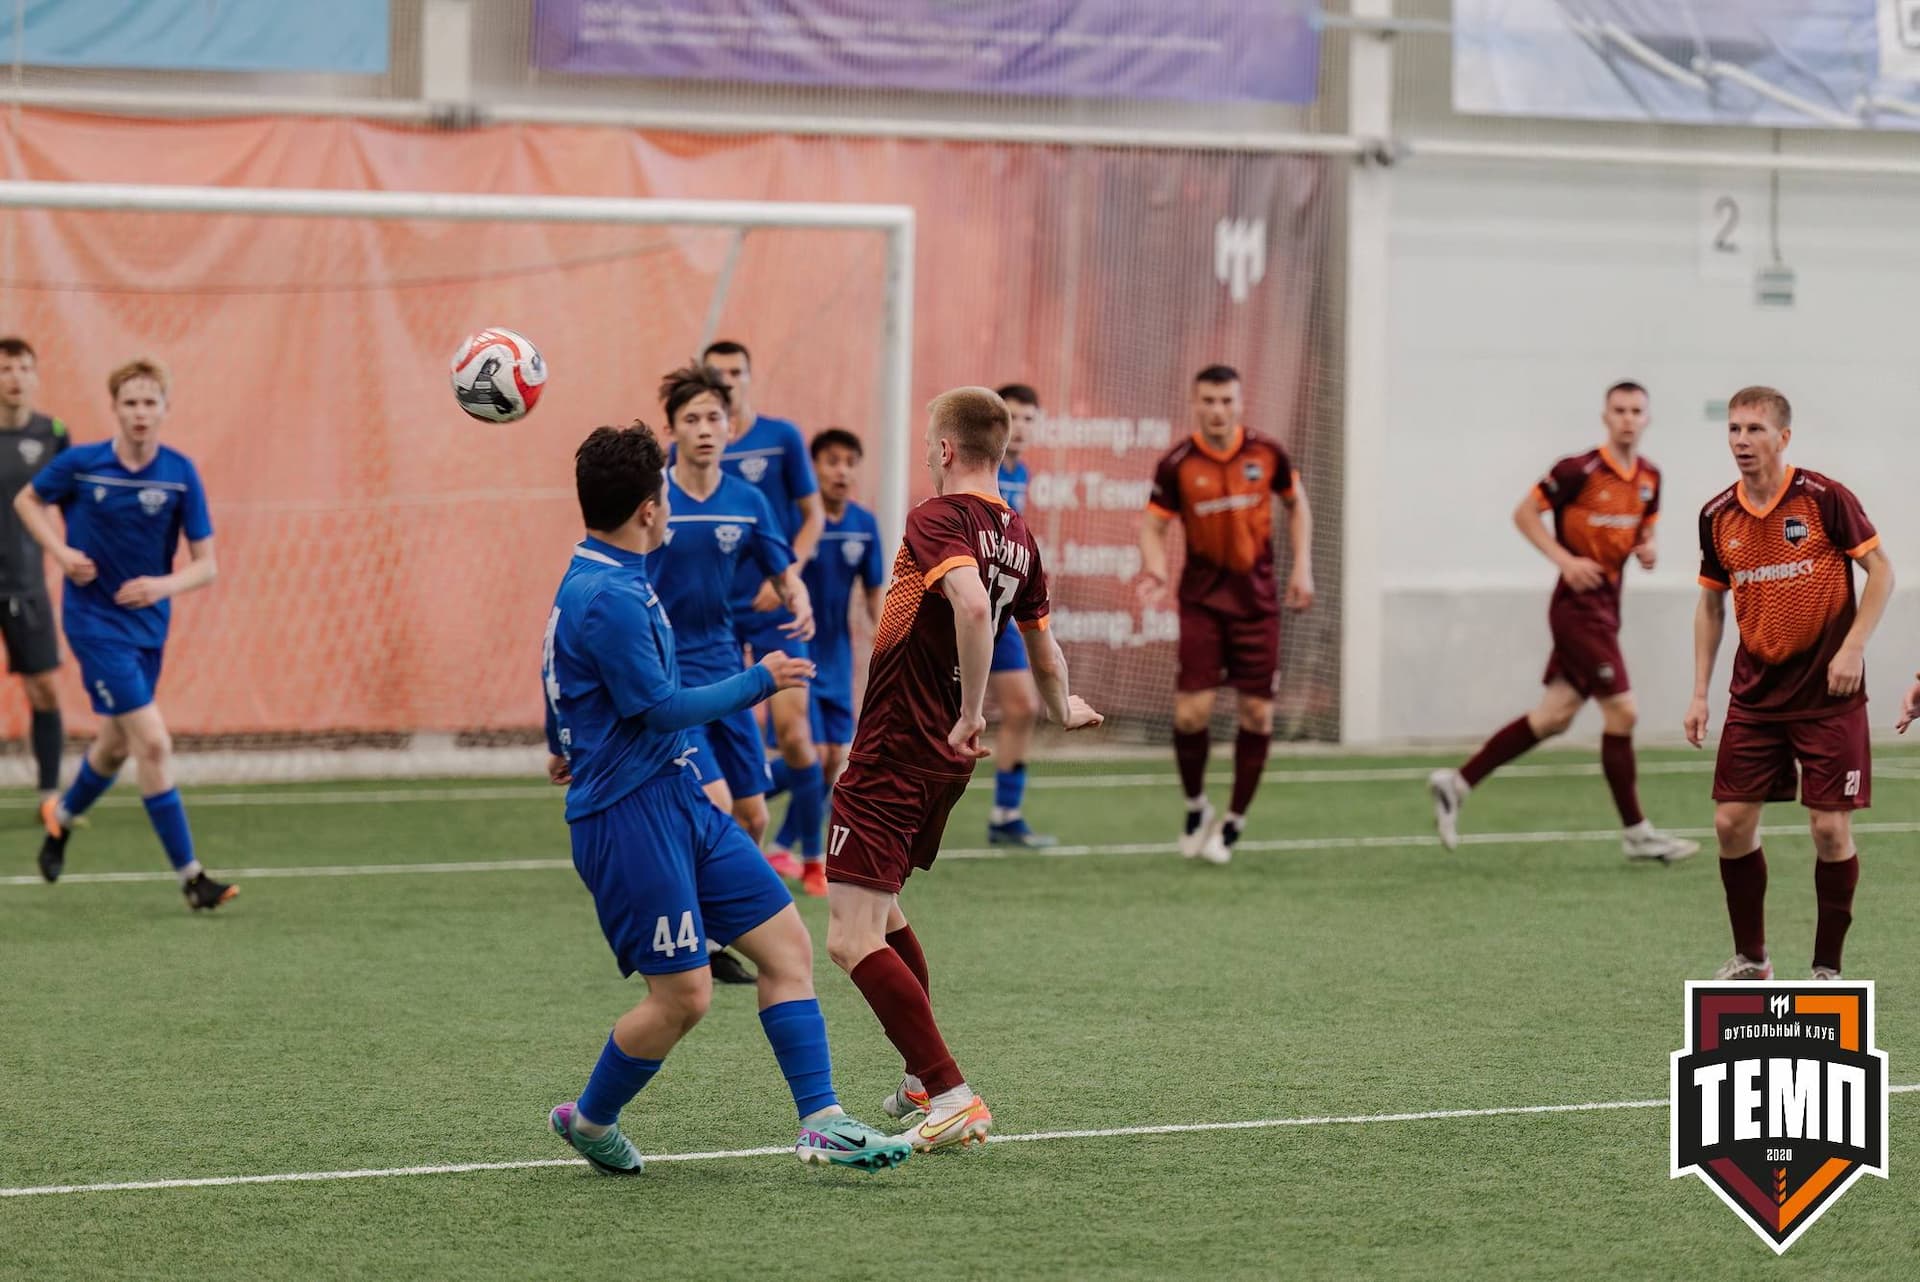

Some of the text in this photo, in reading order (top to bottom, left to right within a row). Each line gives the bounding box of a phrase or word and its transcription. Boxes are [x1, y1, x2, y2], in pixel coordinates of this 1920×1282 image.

[1712, 194, 1740, 253] 2
[829, 824, 851, 857] 17
[652, 910, 699, 958] 44
